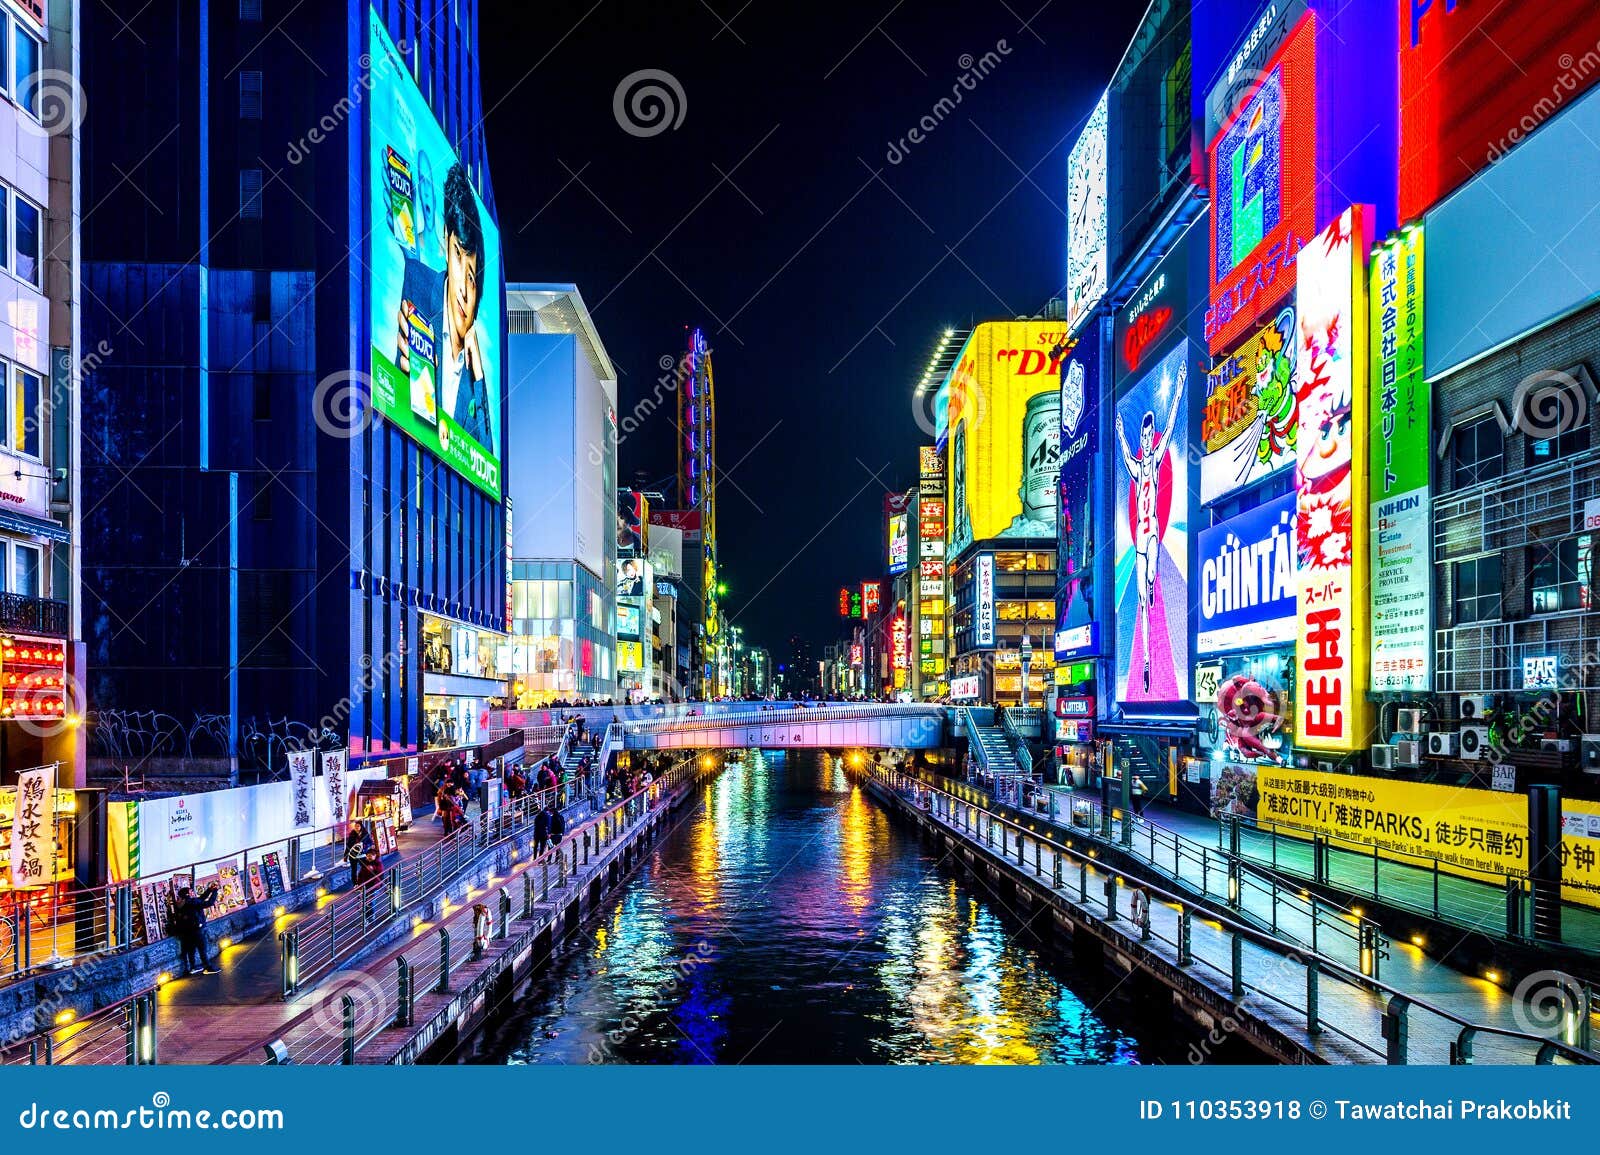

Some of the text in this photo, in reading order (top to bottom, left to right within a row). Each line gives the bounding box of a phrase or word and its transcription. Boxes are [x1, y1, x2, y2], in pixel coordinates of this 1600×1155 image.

[1381, 250, 1397, 494] 株式会社日本リート
[1142, 479, 1151, 535] グリコ
[1378, 494, 1420, 519] NIHON
[1378, 531, 1402, 544] Estate
[1378, 542, 1412, 557] Investment
[1378, 555, 1413, 570] Technology
[1378, 566, 1404, 579] SERVICE
[1378, 575, 1410, 588] PROVIDER
[1305, 581, 1343, 604] スーパー
[1304, 608, 1344, 738] 玉出
[1525, 660, 1556, 679] BAR
[1492, 765, 1515, 780] BAR
[1445, 851, 1459, 864] walk
[1460, 854, 1475, 867] from
[1476, 858, 1492, 871] here!
[1494, 861, 1504, 873] We
